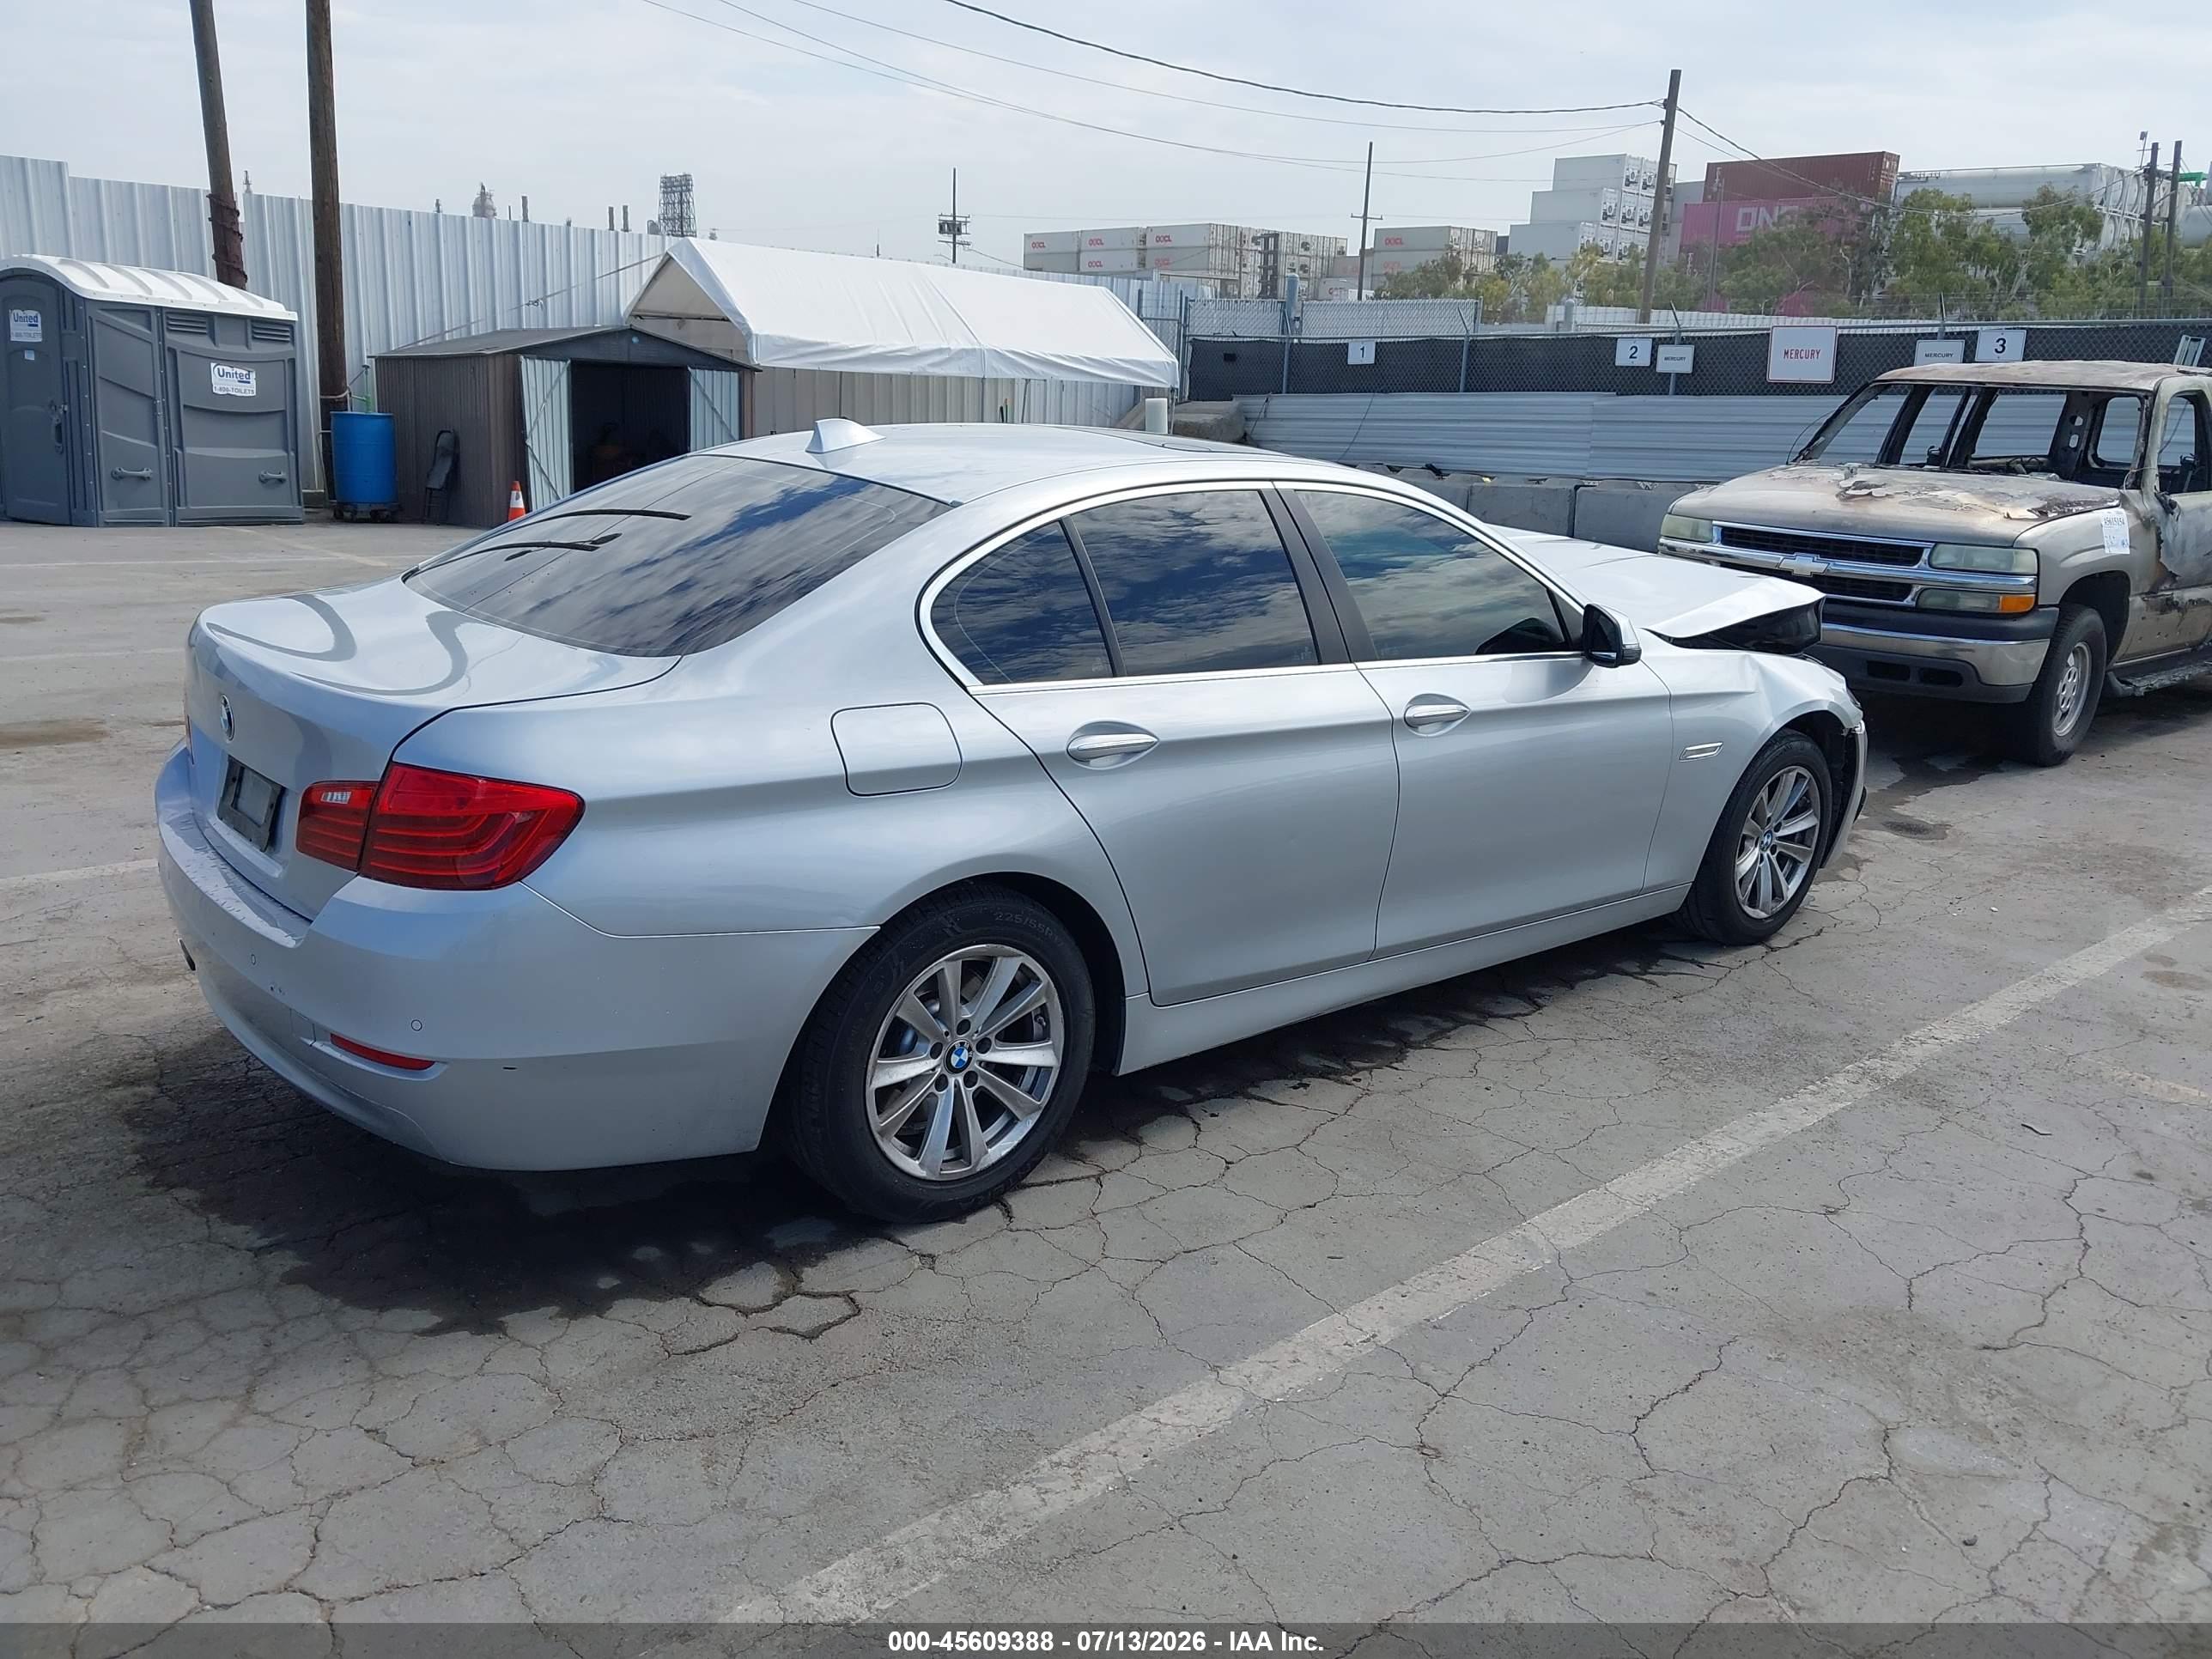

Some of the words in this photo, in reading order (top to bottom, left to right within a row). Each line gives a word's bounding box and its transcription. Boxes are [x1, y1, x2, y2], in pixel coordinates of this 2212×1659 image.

[13, 312, 39, 323] United
[1359, 345, 1365, 358] 1
[1628, 345, 1638, 359] 2
[1994, 337, 2007, 354] 3
[1784, 349, 1821, 360] MERCURY
[217, 367, 251, 380] United
